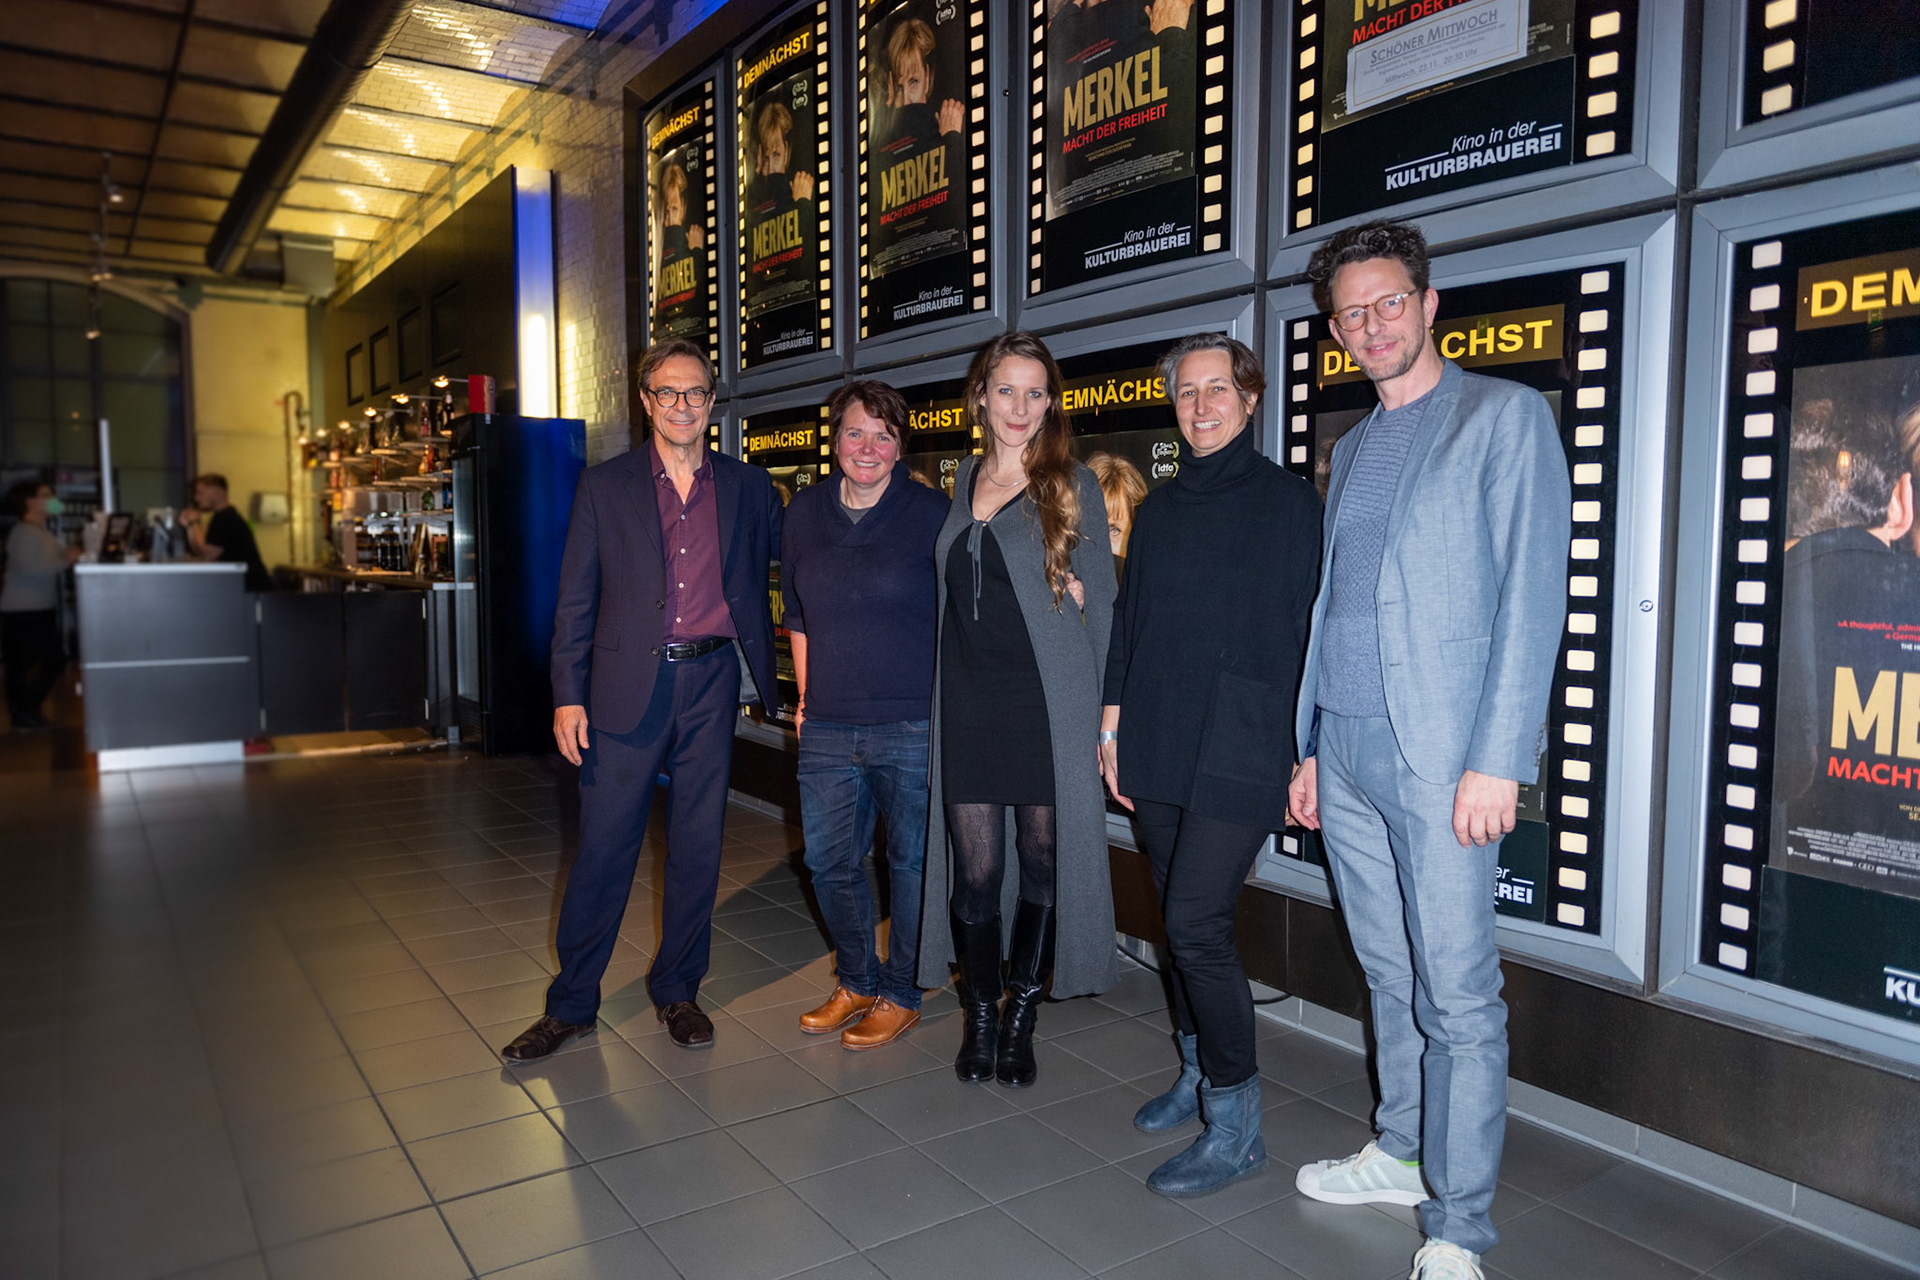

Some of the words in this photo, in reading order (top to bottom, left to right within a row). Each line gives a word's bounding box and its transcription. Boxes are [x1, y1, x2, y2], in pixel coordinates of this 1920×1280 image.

[1352, 8, 1406, 45] MACHT
[1410, 0, 1444, 20] DER
[1371, 34, 1424, 64] SCHÖNER
[1427, 9, 1498, 43] MITTWOCH
[743, 31, 810, 89] DEMNÄCHST
[1063, 45, 1168, 137] MERKEL
[1063, 129, 1094, 155] MACHT
[1096, 121, 1117, 140] DER
[1118, 103, 1168, 132] FREIHEIT
[1451, 135, 1485, 154] Kino
[1489, 128, 1503, 144] in
[1508, 121, 1536, 139] der
[881, 145, 949, 212] MERKEL
[1386, 132, 1561, 190] KULTURBRAUEREI
[753, 208, 803, 262] MERKEL
[1085, 232, 1191, 269] KULTURBRAUEREI
[1124, 230, 1144, 243] Kino
[1146, 225, 1156, 238] in
[1157, 222, 1175, 235] der
[893, 294, 963, 321] KULTURBRAUEREI
[918, 290, 933, 301] Kino
[941, 285, 953, 296] der
[1323, 319, 1553, 377] DECHST
[1062, 377, 1167, 411] EMNÄCHS
[909, 407, 963, 430] ÄCHST
[750, 429, 814, 452] DEMNÄCHST
[1157, 463, 1174, 472] idfa
